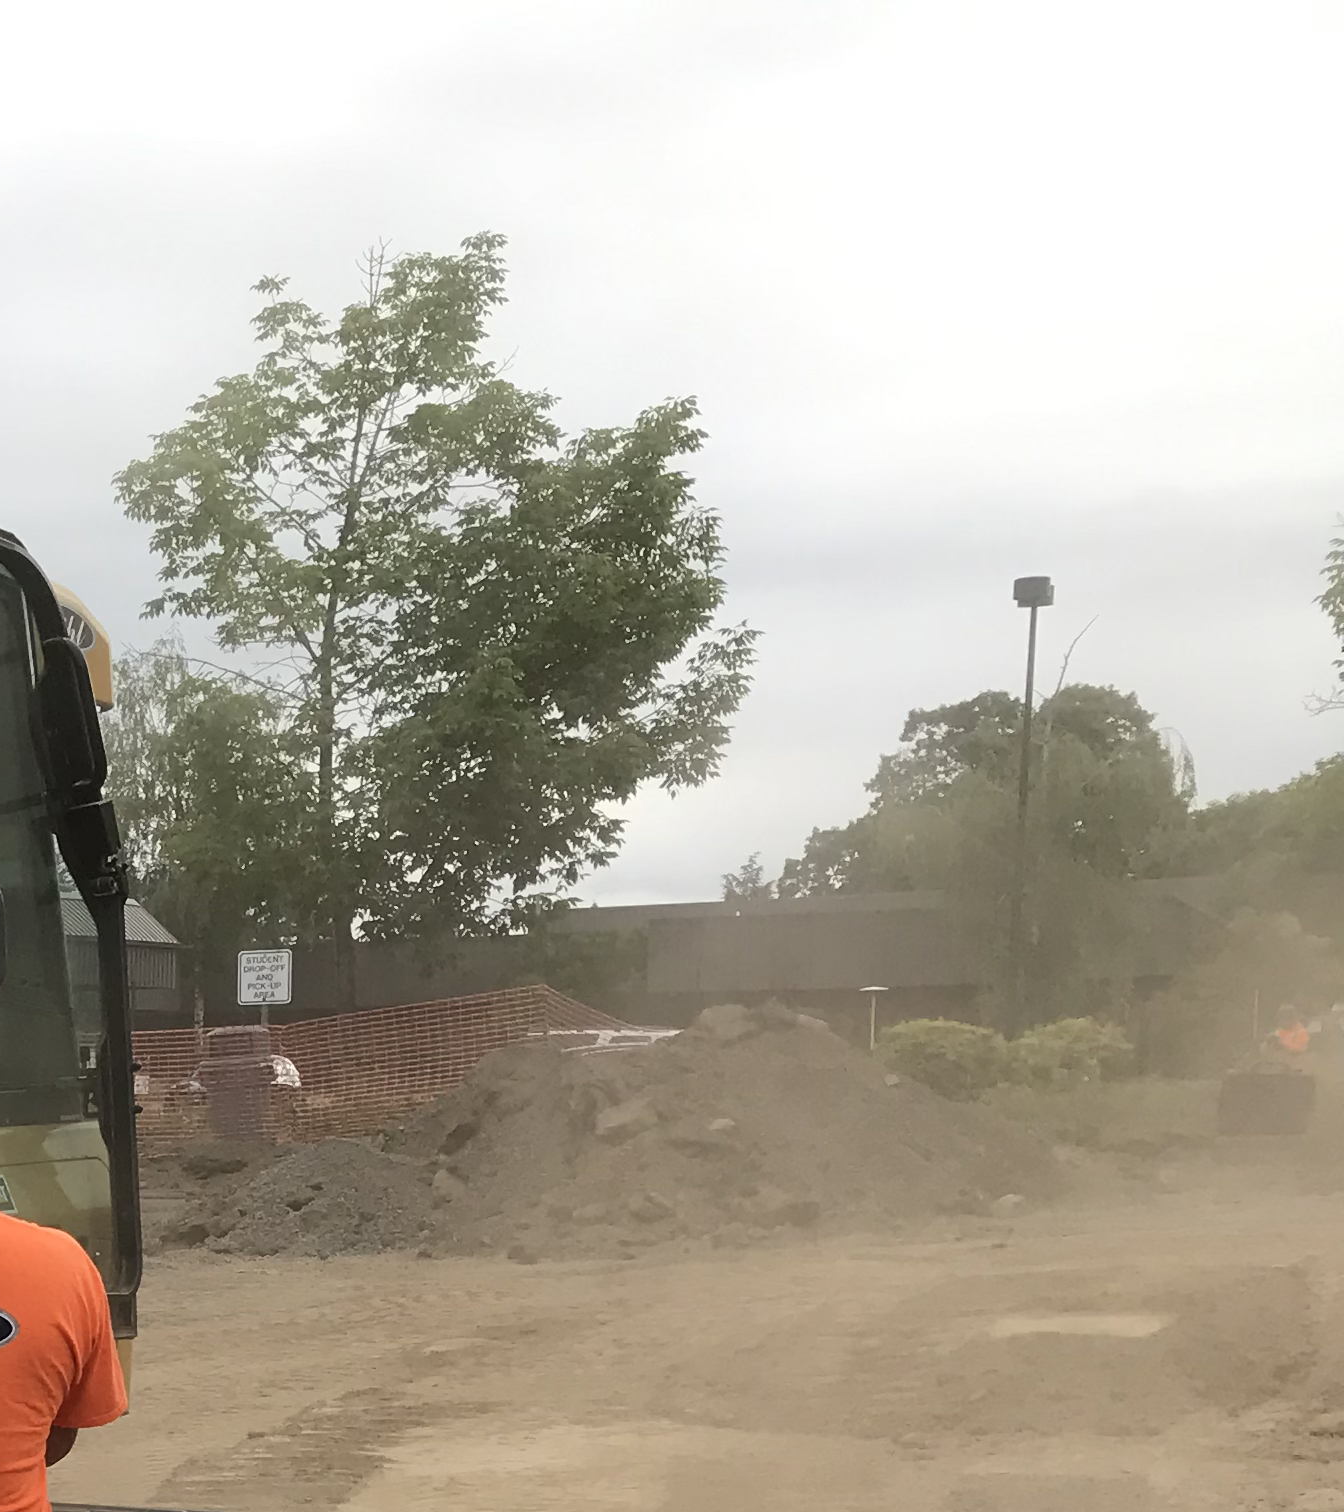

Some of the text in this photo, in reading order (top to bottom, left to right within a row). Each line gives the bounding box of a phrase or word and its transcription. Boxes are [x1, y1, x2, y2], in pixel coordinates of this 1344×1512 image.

[245, 954, 284, 964] STUDENT
[243, 963, 286, 973] DROP-OFF
[256, 973, 273, 981] AND
[247, 981, 281, 990] PICK-UP
[253, 991, 275, 999] AREA
